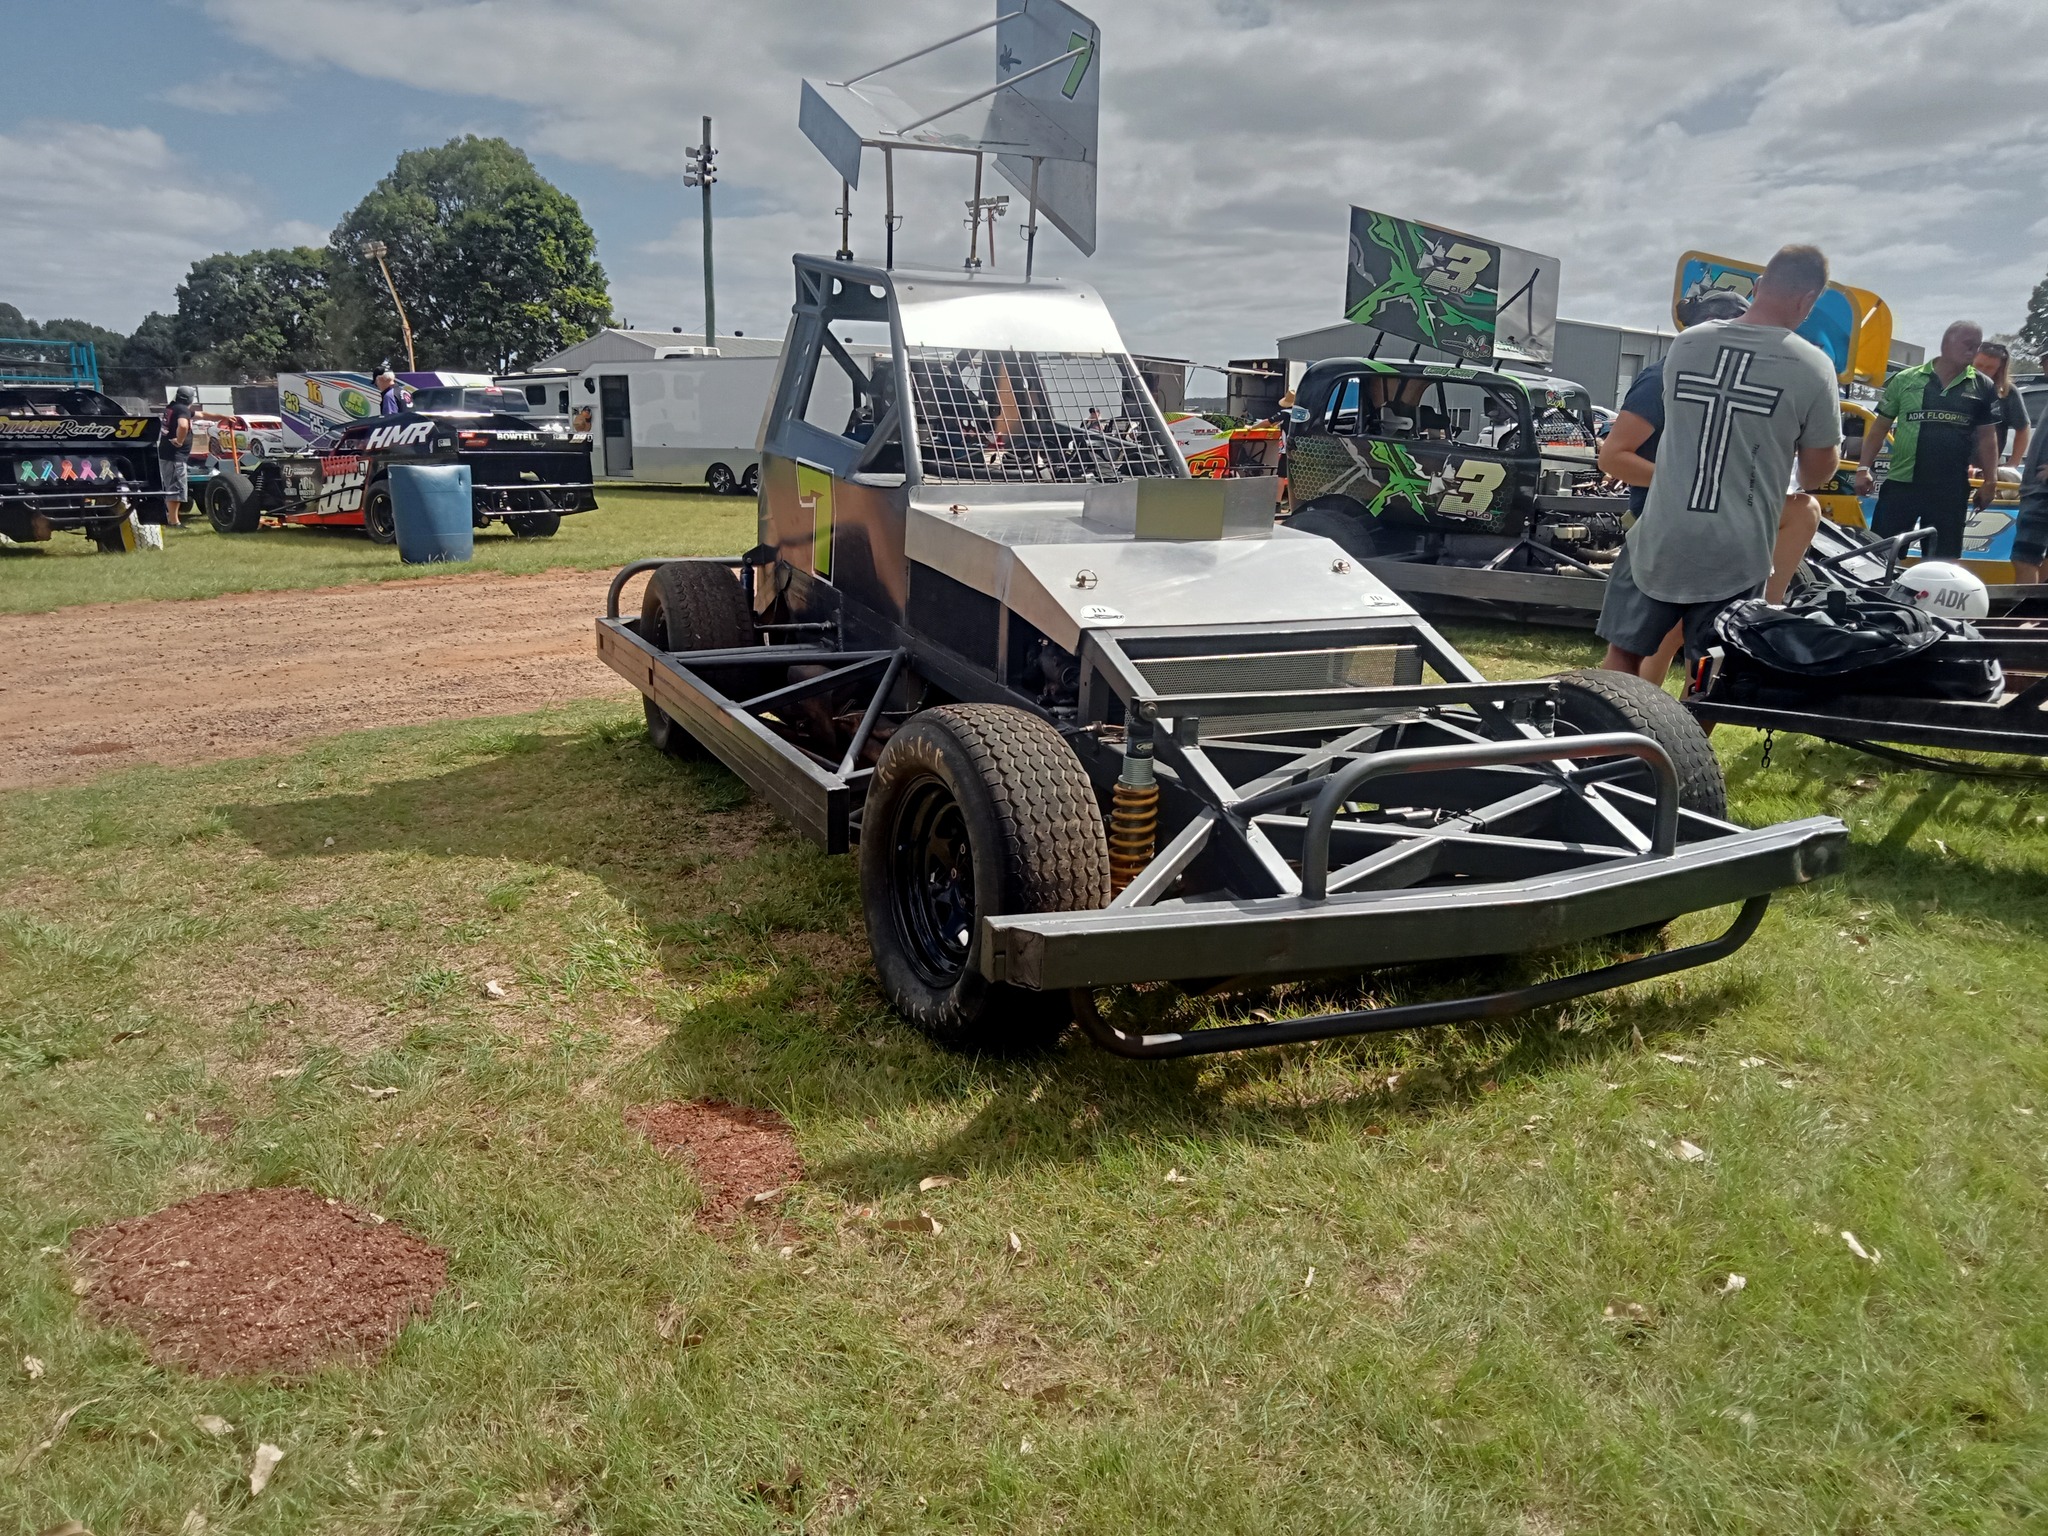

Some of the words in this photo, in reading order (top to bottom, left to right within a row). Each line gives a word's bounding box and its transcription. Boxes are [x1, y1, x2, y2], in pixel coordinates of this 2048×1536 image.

[1061, 29, 1095, 102] 7
[1423, 242, 1492, 294] 3
[284, 390, 300, 414] 23
[304, 378, 324, 408] 16
[56, 419, 116, 439] Racing
[115, 418, 148, 439] 51
[1908, 412, 1925, 420] ADK
[365, 421, 435, 451] HMR
[1437, 458, 1507, 517] 3
[796, 457, 836, 586] 7
[1465, 509, 1493, 521] QLD
[1933, 588, 1971, 612] ADK
